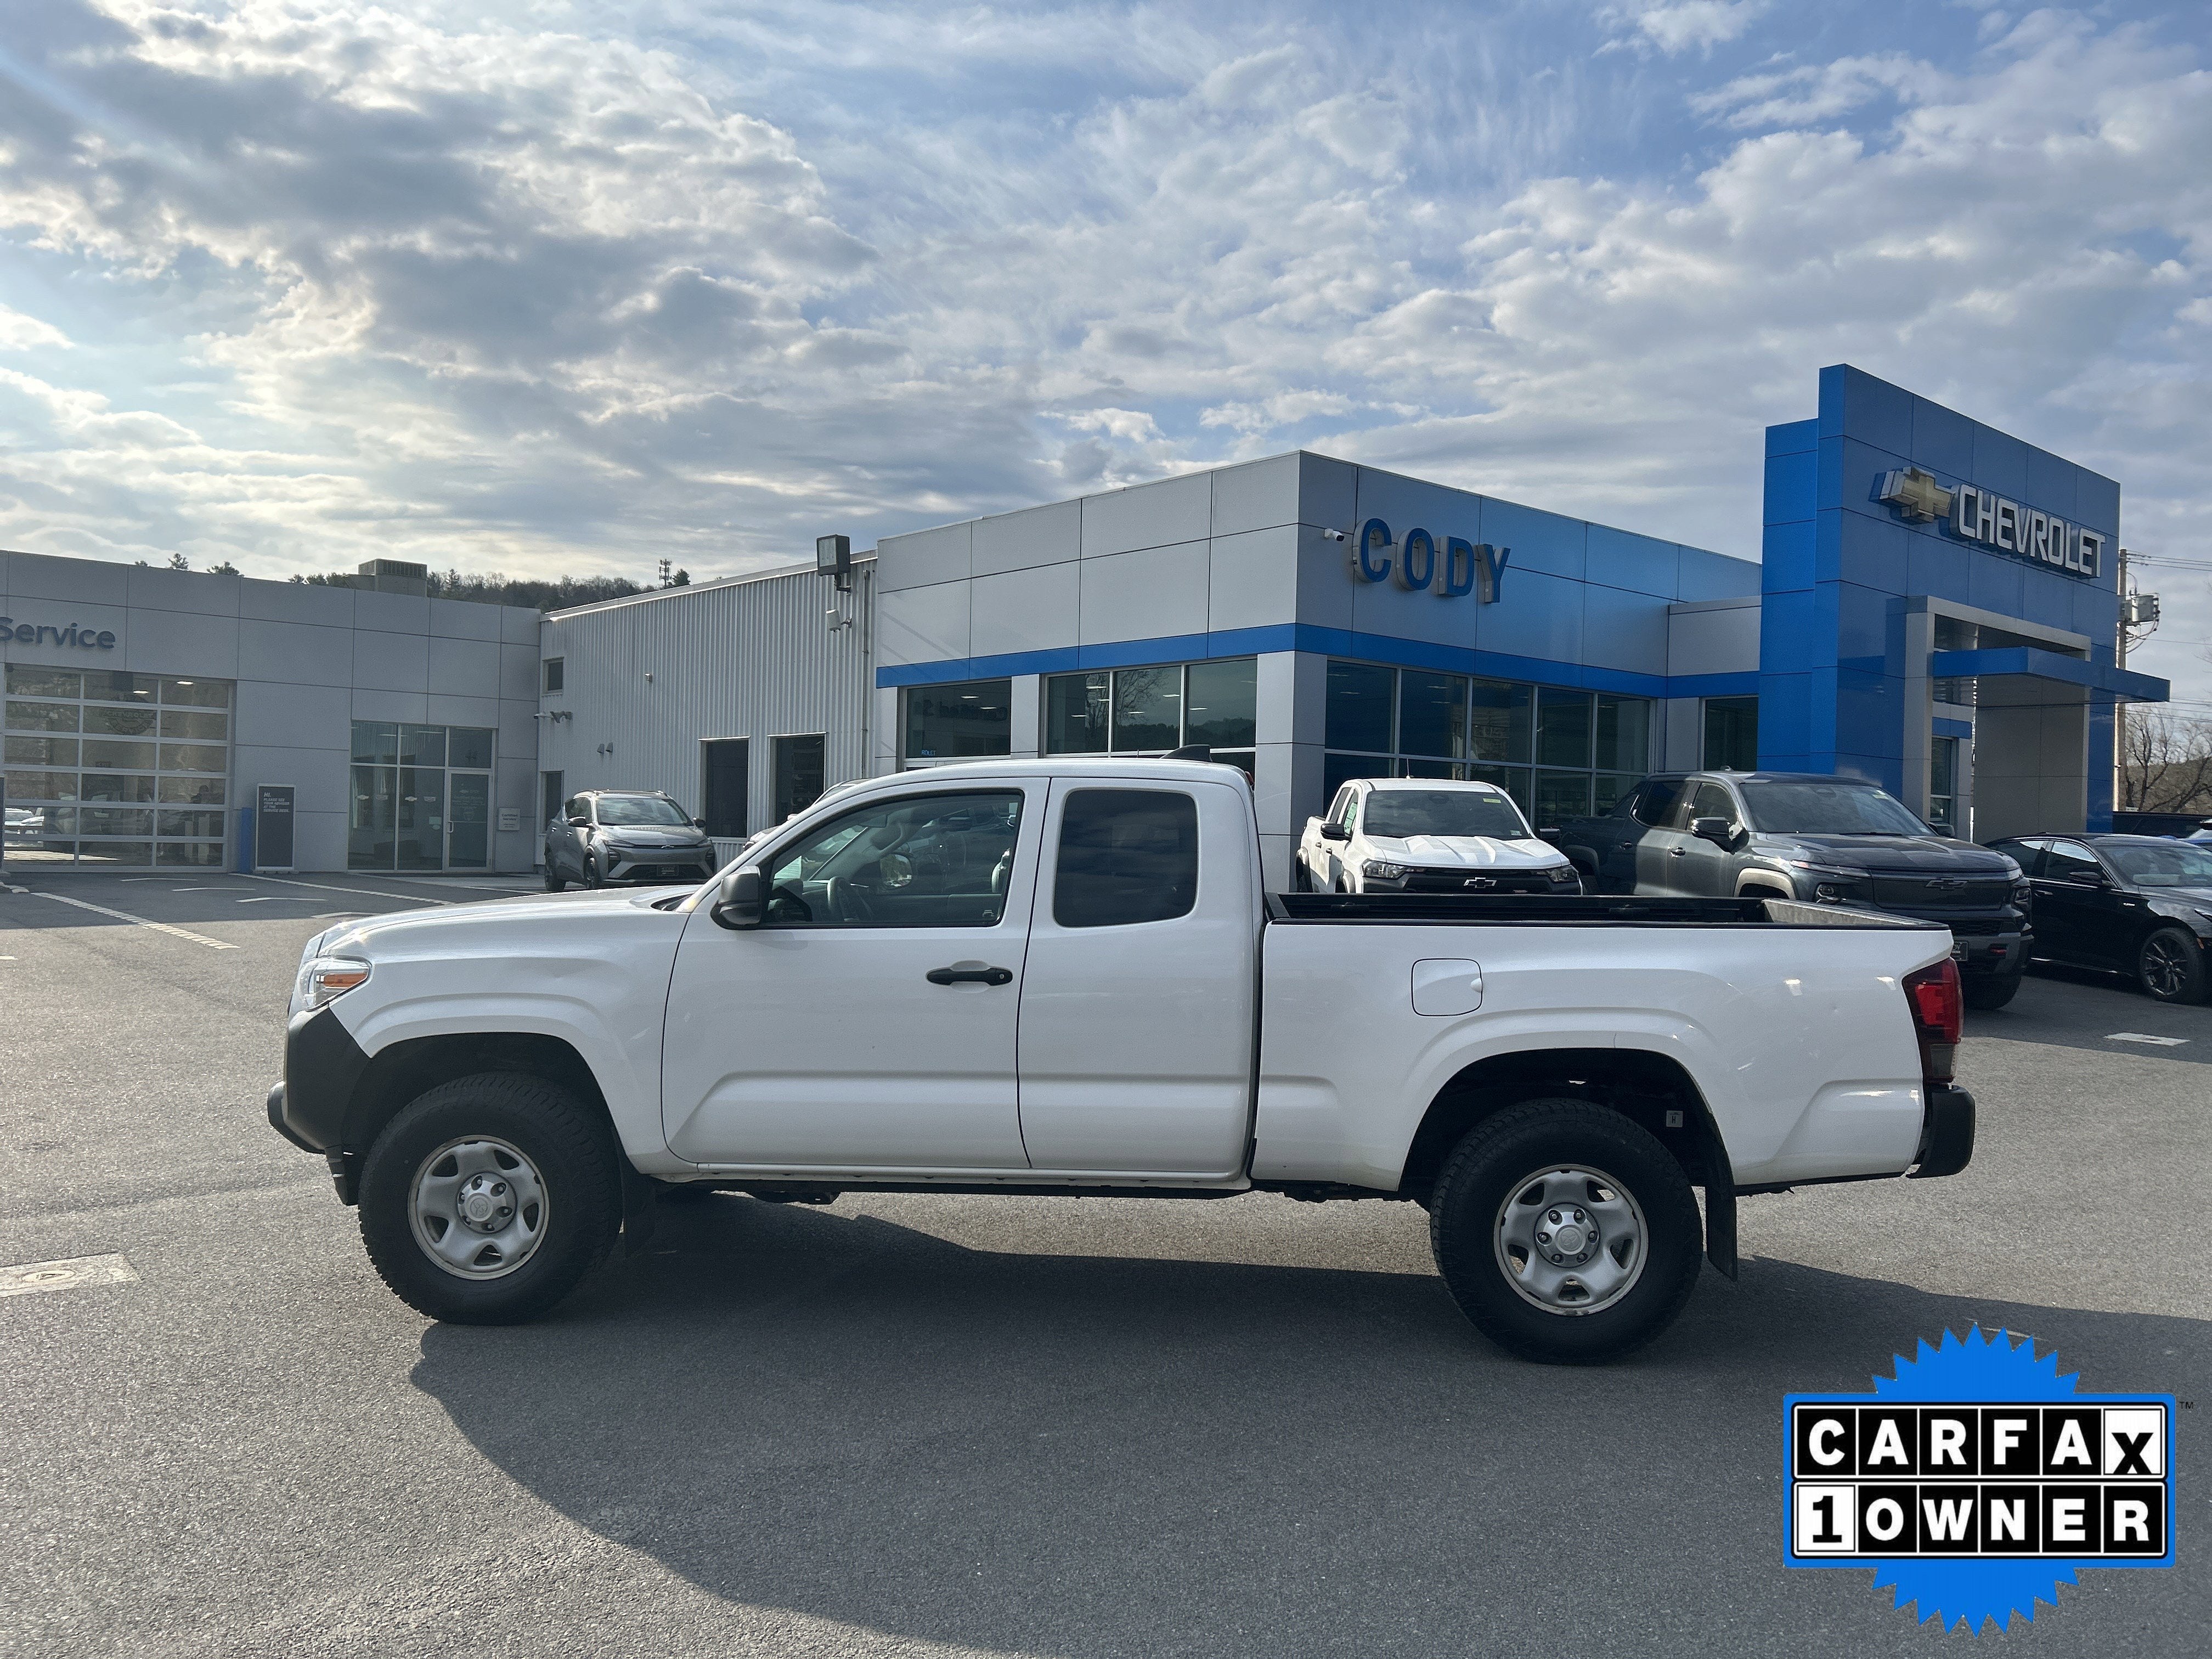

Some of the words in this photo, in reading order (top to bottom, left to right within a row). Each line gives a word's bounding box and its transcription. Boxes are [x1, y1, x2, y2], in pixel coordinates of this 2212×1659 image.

[1353, 518, 1511, 603] CODY
[1955, 484, 2106, 578] CHEVROLET
[0, 617, 115, 649] Service
